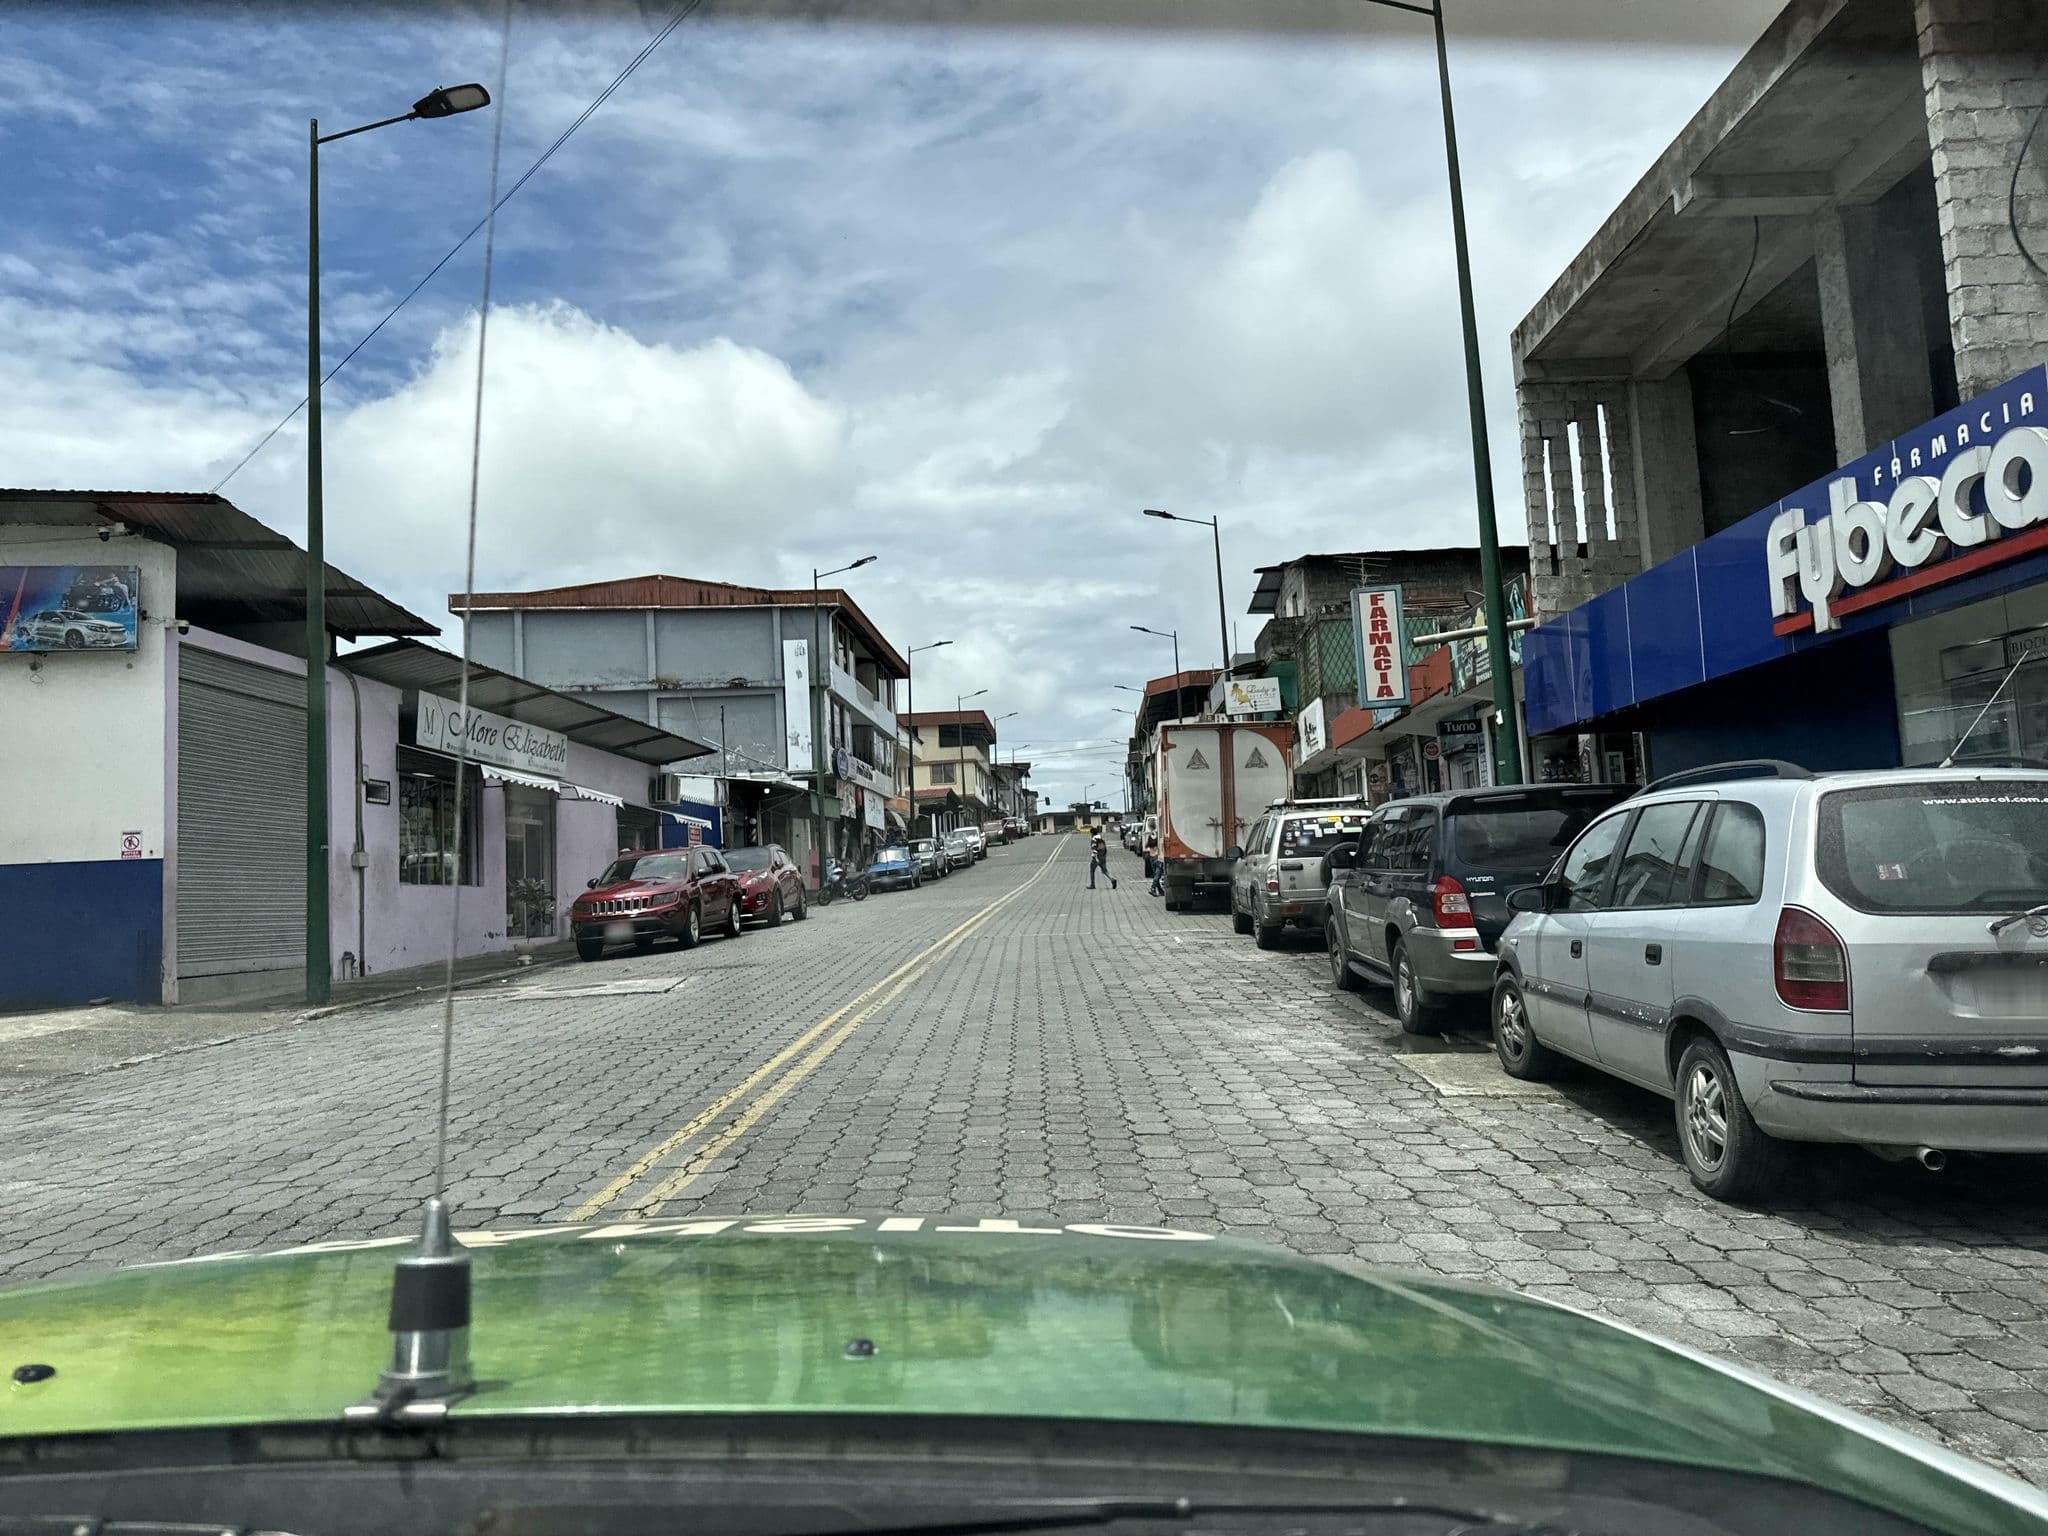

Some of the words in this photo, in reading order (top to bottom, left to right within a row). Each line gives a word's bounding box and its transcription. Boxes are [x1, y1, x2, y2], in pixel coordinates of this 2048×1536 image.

[1873, 391, 2035, 487] FARMACIA
[1368, 593, 1395, 698] FARMACIA
[448, 709, 498, 746] More
[503, 723, 567, 763] Elizabeth
